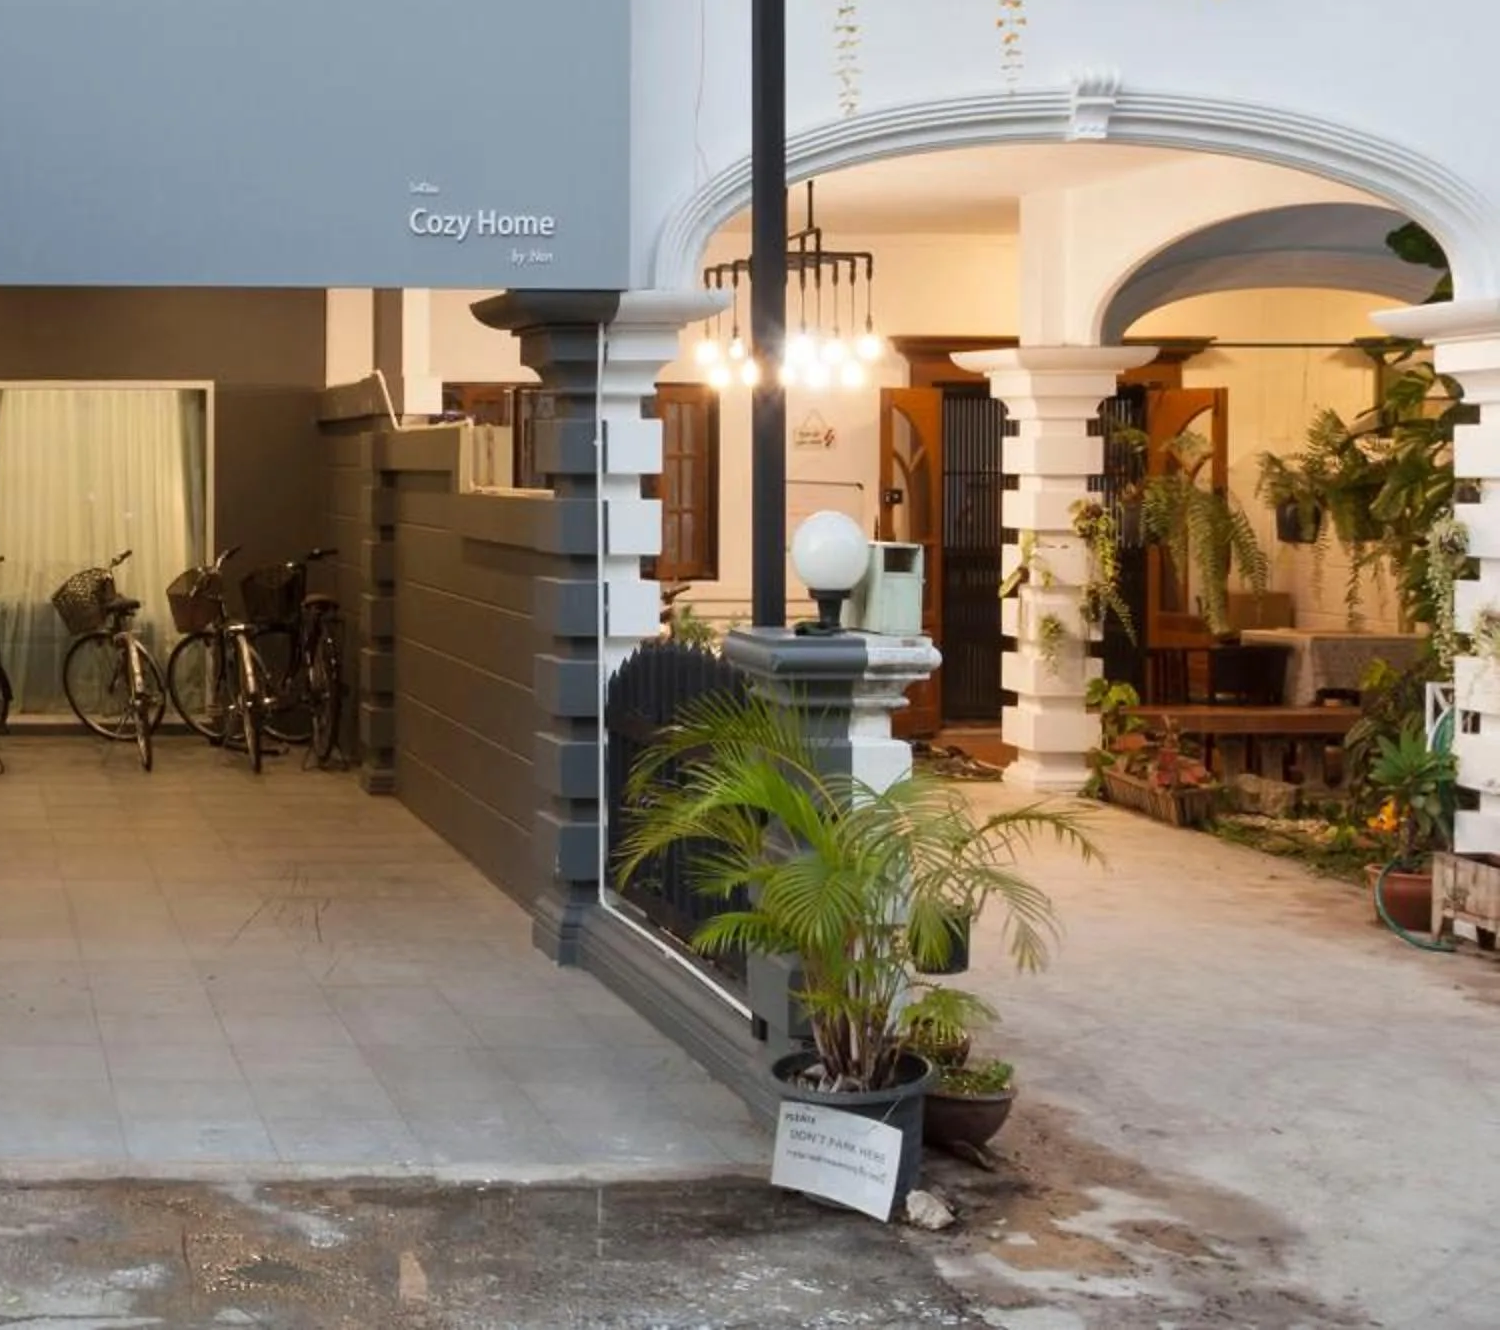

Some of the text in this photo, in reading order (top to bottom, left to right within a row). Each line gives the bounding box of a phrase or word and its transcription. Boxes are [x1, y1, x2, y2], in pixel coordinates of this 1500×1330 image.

[409, 207, 555, 241] Cozy Home
[511, 248, 525, 266] by
